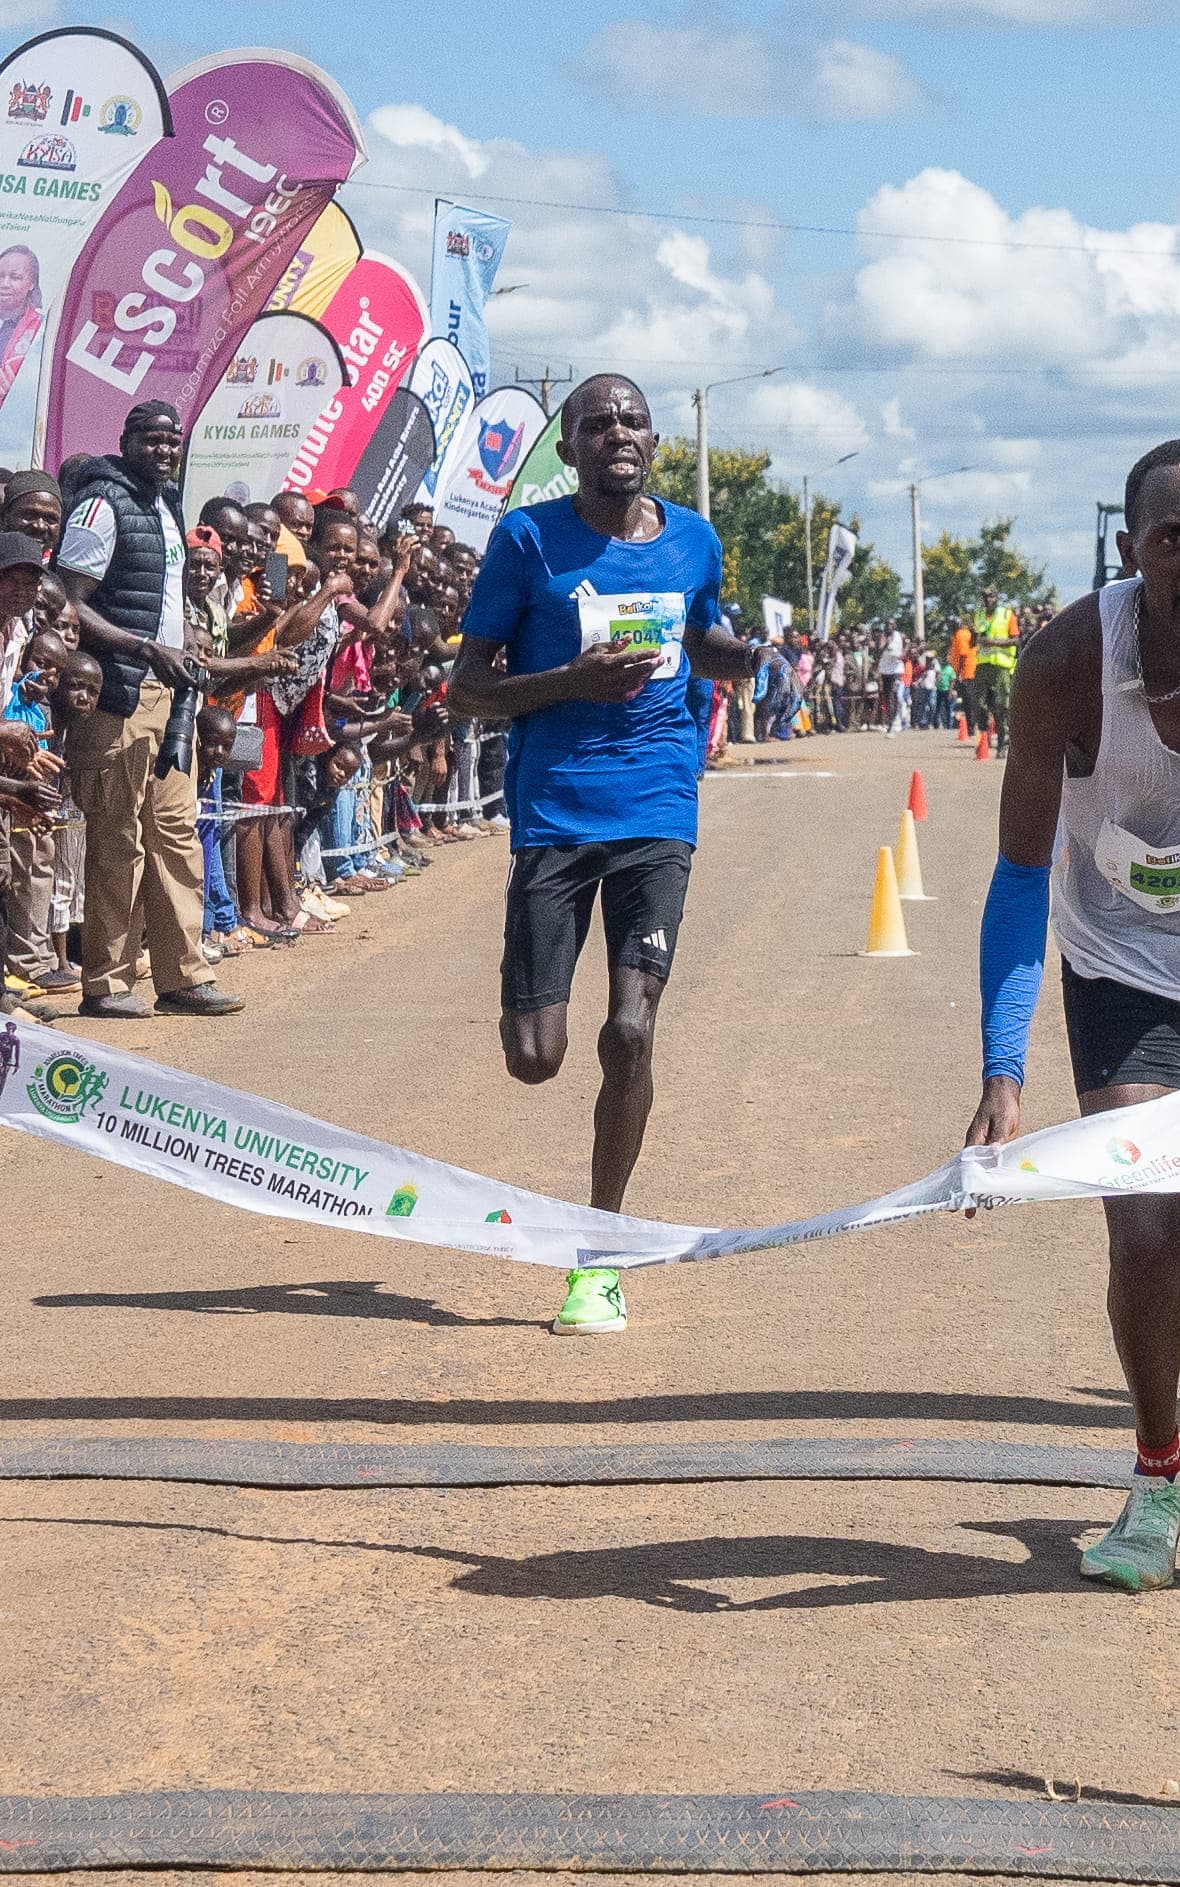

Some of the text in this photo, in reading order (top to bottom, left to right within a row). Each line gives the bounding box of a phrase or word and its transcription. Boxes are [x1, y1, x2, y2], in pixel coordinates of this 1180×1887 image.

[33, 177, 102, 202] GAMES
[65, 134, 278, 396] Escort
[172, 327, 227, 412] ngamiza
[223, 285, 249, 326] Fall
[383, 341, 407, 369] SC
[204, 424, 300, 440] KYISA GAMES
[377, 467, 391, 492] And
[400, 406, 420, 443] Rivers
[444, 502, 491, 521] Kindergarten
[37, 1083, 72, 1113] MARATHON
[96, 1111, 116, 1133] 10
[120, 1120, 200, 1163] MILLION
[204, 1149, 263, 1187] TREES
[119, 1086, 227, 1143] LUKENYA
[233, 1125, 370, 1191] UNIVERSITY
